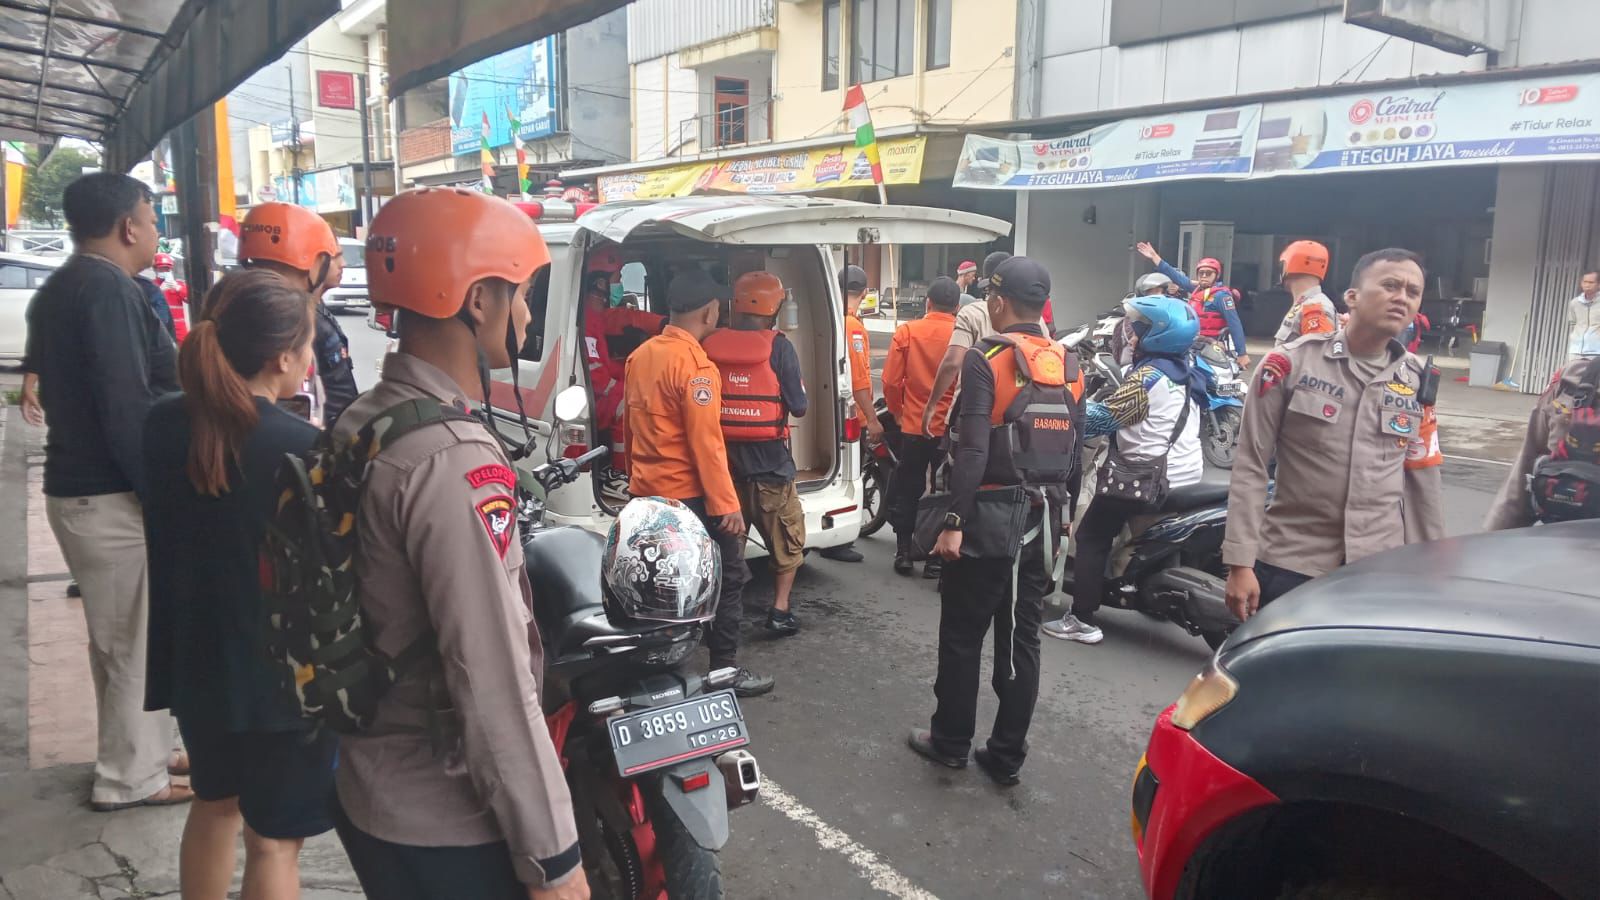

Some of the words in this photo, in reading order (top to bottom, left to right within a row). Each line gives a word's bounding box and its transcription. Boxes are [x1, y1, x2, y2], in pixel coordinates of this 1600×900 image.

[1375, 91, 1446, 116] Central
[1510, 119, 1553, 131] #Tidur
[1556, 118, 1592, 129] Relax
[888, 144, 916, 155] maxim
[1351, 147, 1409, 165] TEGUH
[1412, 144, 1455, 161] JAYA
[1458, 141, 1515, 158] meubel
[1034, 172, 1074, 185] TEGUH
[1075, 170, 1103, 184] JAYA
[1299, 374, 1345, 399] ADITYA
[1034, 418, 1070, 431] BASARNAS
[651, 689, 681, 700] HONDA
[618, 725, 632, 746] D
[640, 711, 687, 739] 3859
[699, 700, 733, 724] UCS
